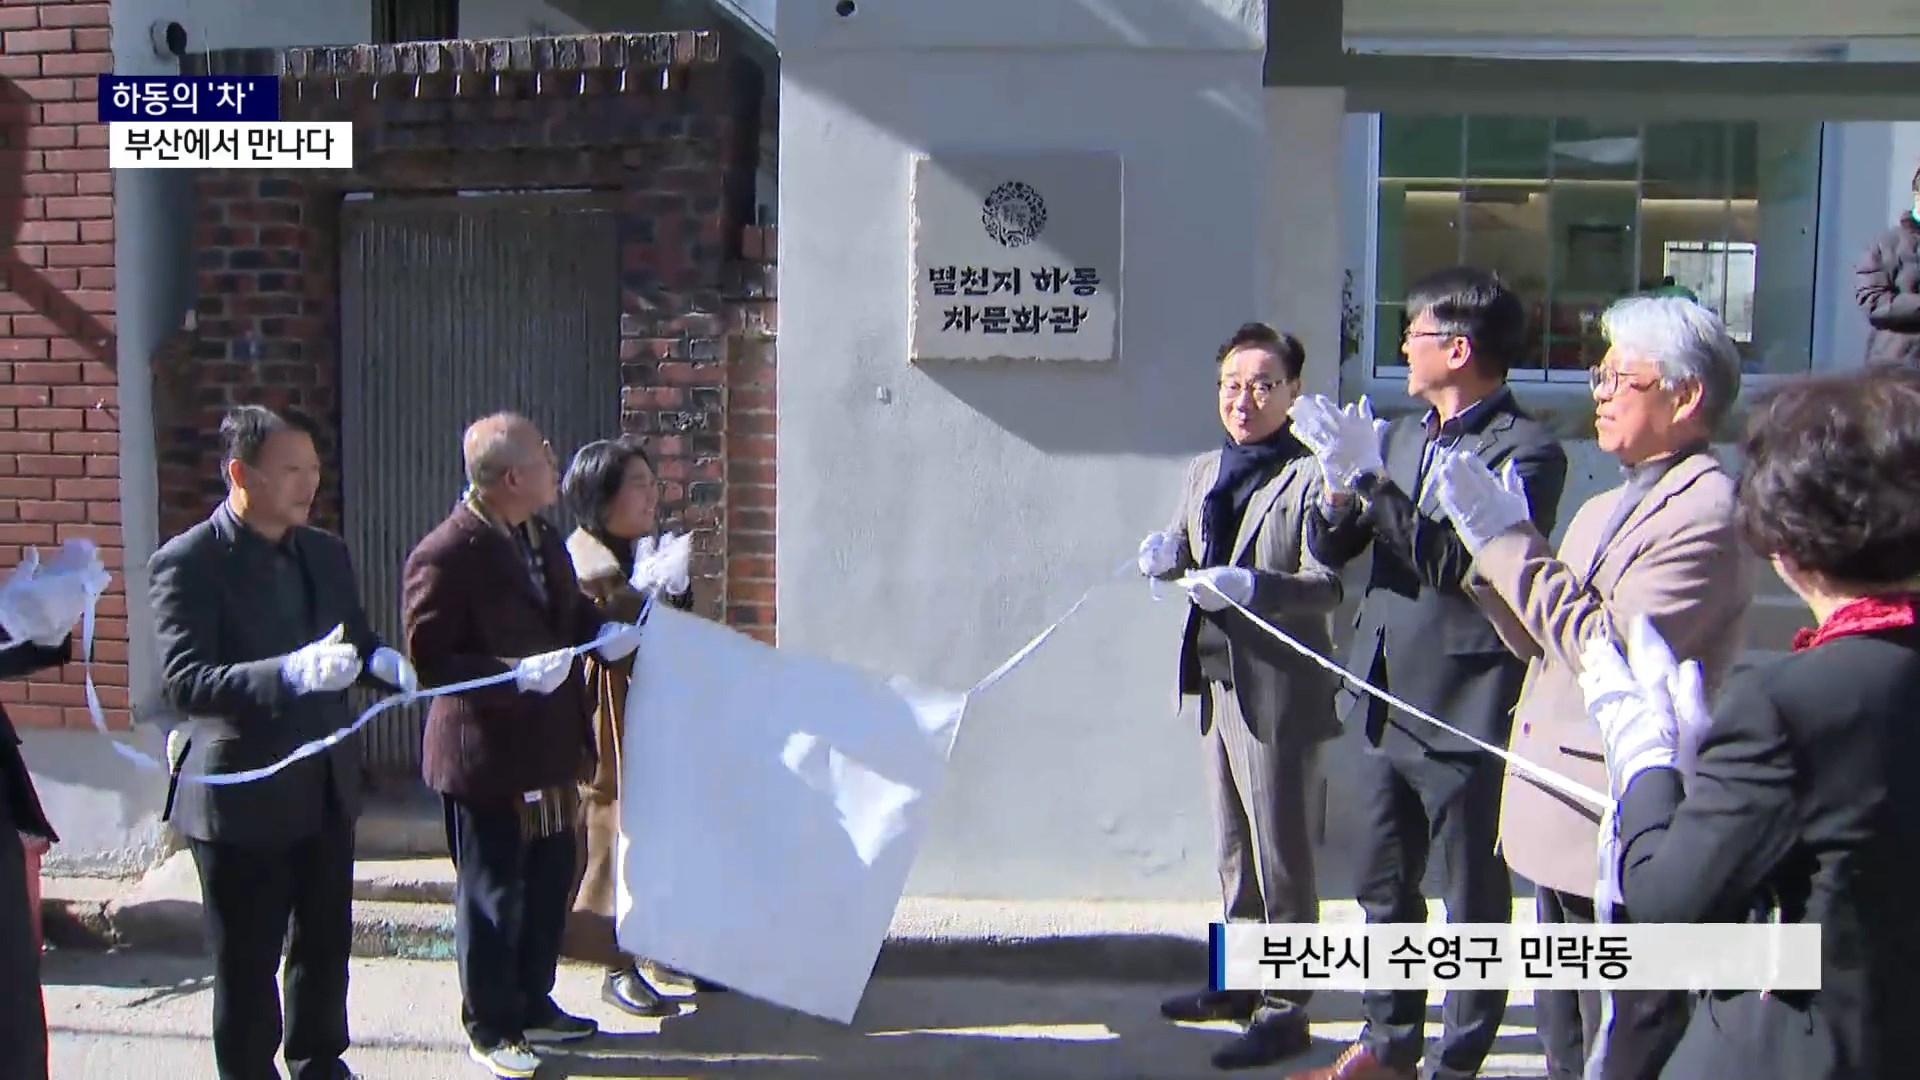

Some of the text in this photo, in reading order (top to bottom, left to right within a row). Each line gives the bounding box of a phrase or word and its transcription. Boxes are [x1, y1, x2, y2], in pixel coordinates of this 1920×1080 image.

[929, 265, 1101, 297] 별천지 하동
[941, 304, 1090, 335] 차문화관
